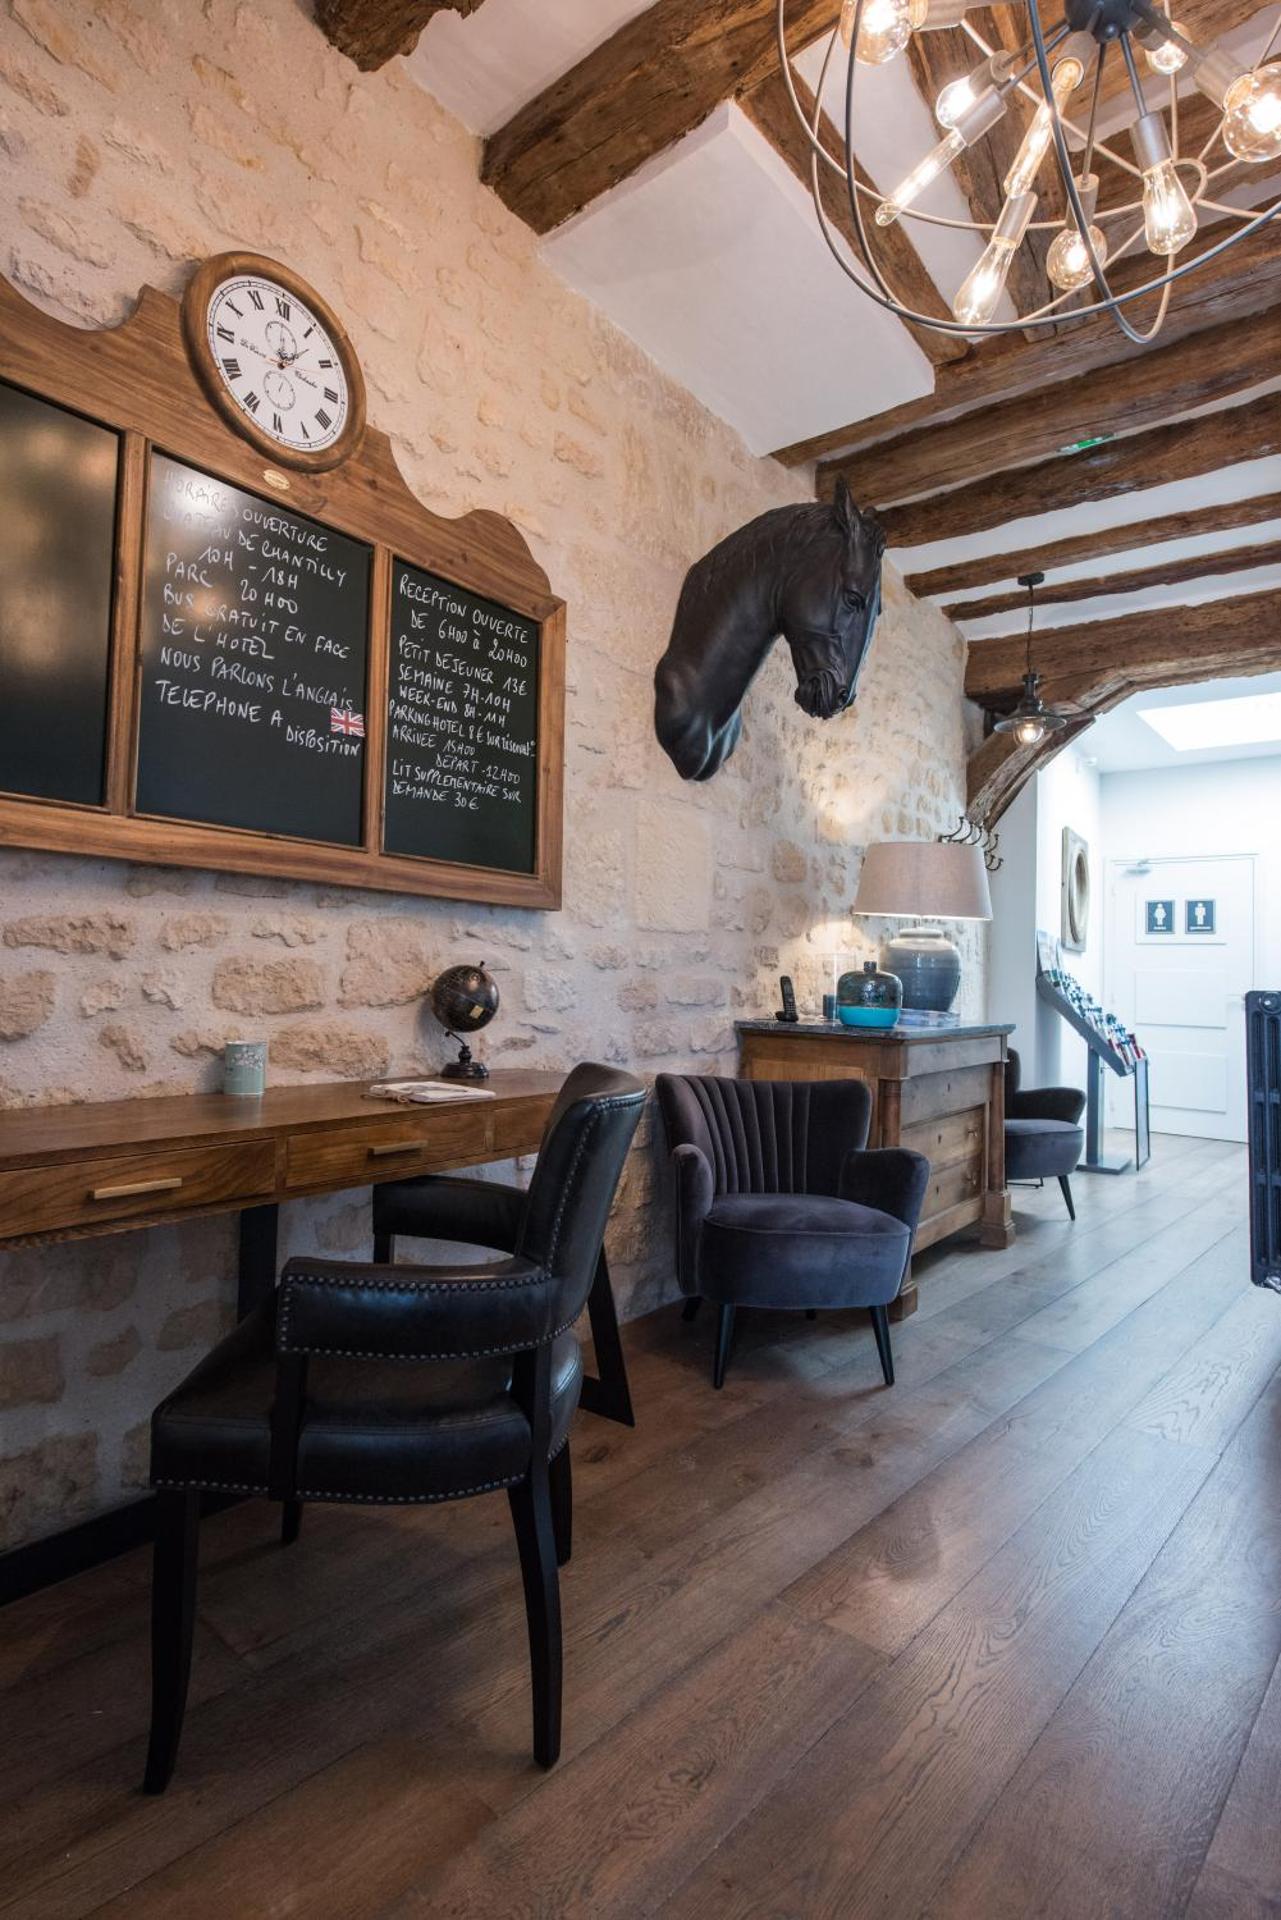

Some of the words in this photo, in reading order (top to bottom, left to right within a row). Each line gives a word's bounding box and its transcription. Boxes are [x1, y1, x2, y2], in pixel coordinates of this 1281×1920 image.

[225, 299, 244, 320] X
[247, 290, 265, 311] XI
[275, 297, 291, 322] XII
[318, 359, 334, 369] II
[324, 386, 339, 405] III
[242, 508, 328, 552] OUVERTURE
[166, 552, 213, 588] PARC
[238, 530, 259, 551] DE
[261, 541, 348, 587] CHANTILLY
[261, 567, 298, 590] 18H
[162, 614, 186, 636] DE
[164, 583, 194, 607] BUS
[205, 604, 280, 634] GRATUIT
[284, 625, 307, 645] EN
[314, 635, 351, 659] FACE
[400, 574, 466, 617] RECEPTION
[472, 609, 528, 644] OUVERTE
[411, 609, 429, 629] DE
[438, 619, 468, 644] 6H00
[399, 634, 431, 663] PETIT
[435, 651, 494, 684] DEJEUNER
[160, 646, 201, 673] NOUS
[211, 656, 275, 693] PARLONS
[282, 672, 353, 711] L'ANGLAIS
[398, 663, 454, 695] SEMAINE
[155, 680, 262, 723] TELEPHONE
[270, 709, 283, 728] A
[389, 699, 431, 726] PARKING
[433, 716, 464, 737] HOTEL
[286, 725, 360, 757] DISPOSITION
[392, 725, 437, 748] ARRIVEE
[436, 753, 480, 774] DEPART
[392, 758, 411, 777] LIT
[414, 766, 499, 797] SUPPLEMENTAIRE
[502, 788, 522, 803] SUR
[392, 779, 449, 801] DEMANDE
